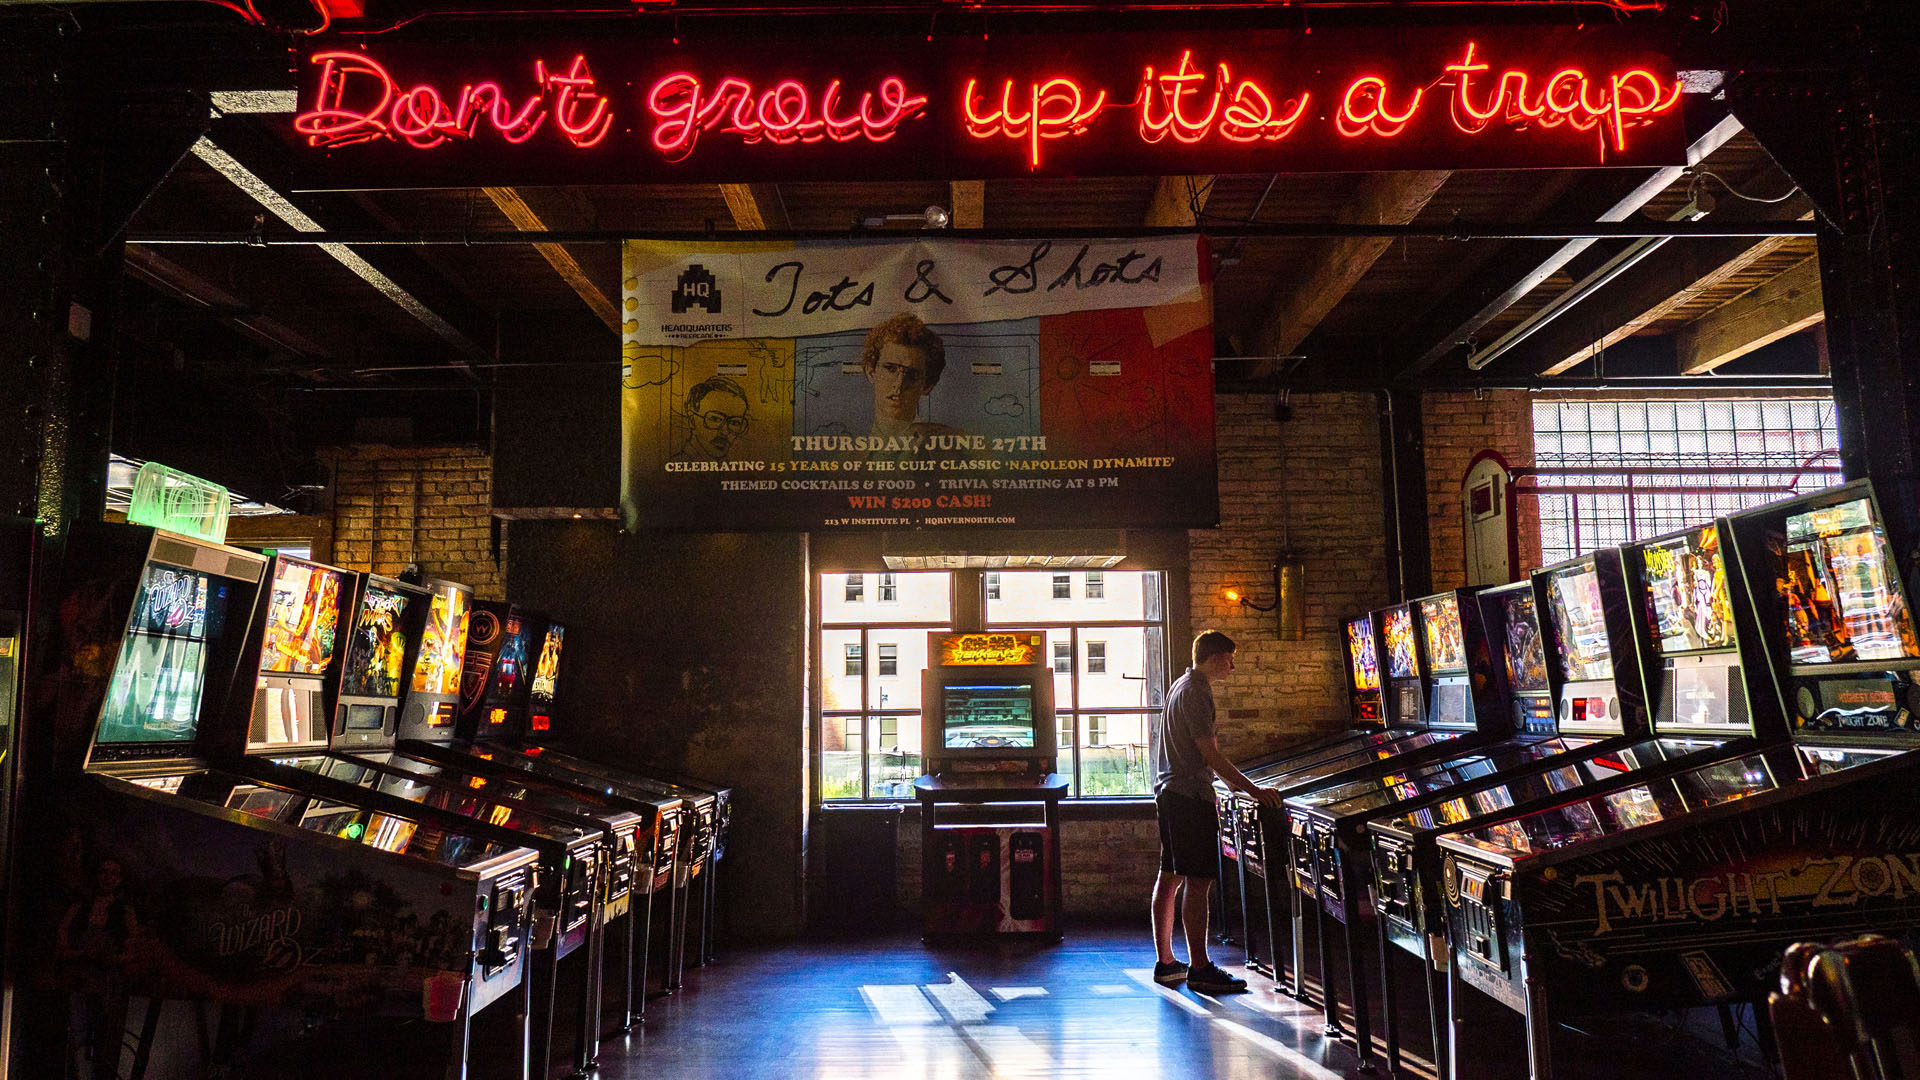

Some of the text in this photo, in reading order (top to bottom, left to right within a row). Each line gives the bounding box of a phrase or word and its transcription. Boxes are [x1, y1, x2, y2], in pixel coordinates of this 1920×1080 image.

[295, 42, 1683, 170] Don't grow up it's a trap
[753, 240, 1162, 317] Tots & Shots
[683, 282, 710, 298] HQ
[661, 324, 733, 333] HEADQUARTERS
[790, 435, 1047, 454] THURSDAY, JUNE 27TH
[664, 461, 765, 472] CELEBRATING
[770, 462, 785, 472] 15
[790, 461, 839, 471] YEARS
[843, 461, 861, 471] OF
[866, 461, 895, 471] THE
[899, 461, 935, 471] CULT
[940, 460, 1001, 470] CLASSIC
[721, 477, 1119, 490] THEMED COCKTAILS & FOOD TRIVIA STARTING AT 8 PM
[848, 495, 991, 509] WIN $200 CASH!
[852, 517, 898, 525] INSTITUTE
[900, 517, 911, 525] PL
[1574, 869, 1786, 937] TWILIGHT
